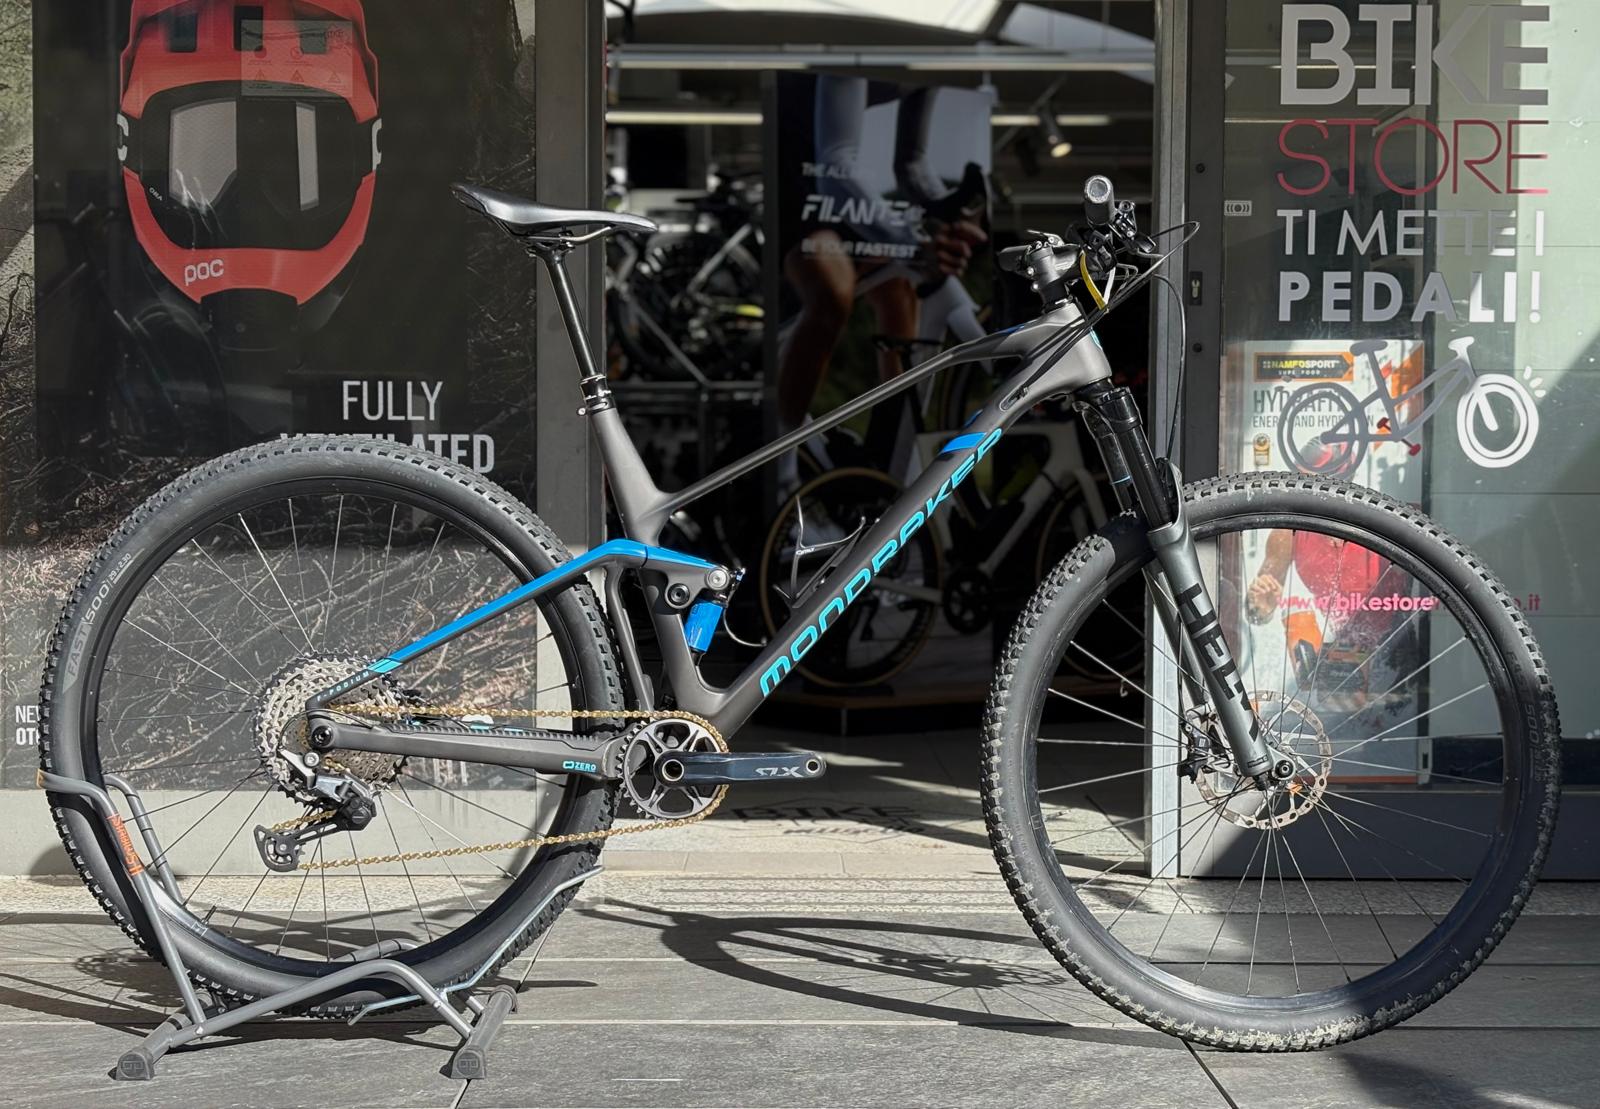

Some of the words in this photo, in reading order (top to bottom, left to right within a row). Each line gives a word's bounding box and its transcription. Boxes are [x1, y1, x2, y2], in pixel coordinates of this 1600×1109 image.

[1280, 4, 1550, 106] BIKE
[1277, 117, 1549, 196] STORE
[854, 241, 918, 258] FASTEST
[1277, 209, 1316, 256] TI
[1336, 209, 1517, 257] METTE
[1535, 209, 1545, 257] I
[1278, 270, 1542, 324] PEDALI!
[342, 380, 443, 421] FULLY
[1294, 415, 1315, 427] AND
[67, 624, 90, 678] FAST
[85, 583, 110, 623] 500
[574, 761, 597, 772] ZERO
